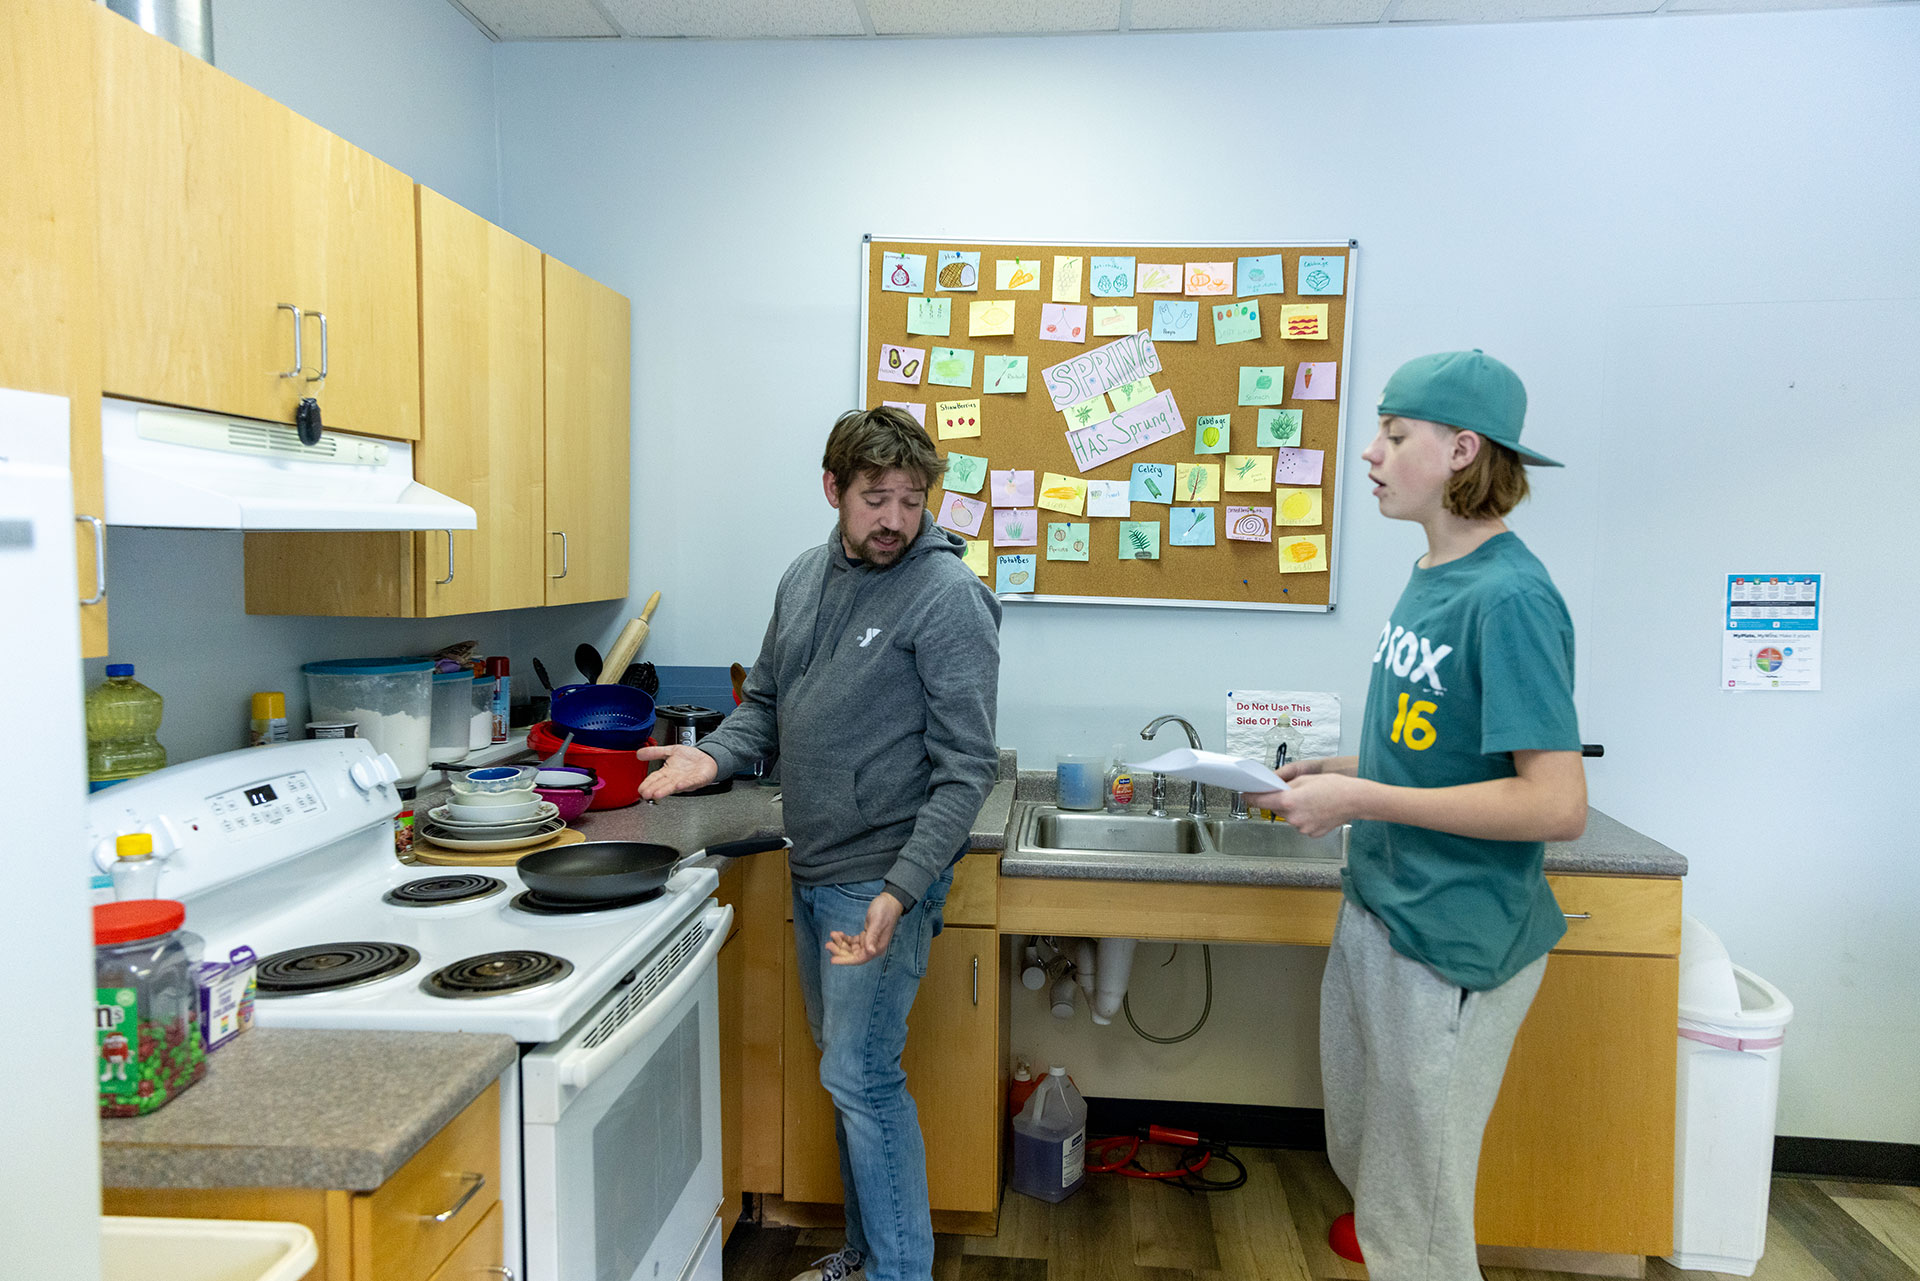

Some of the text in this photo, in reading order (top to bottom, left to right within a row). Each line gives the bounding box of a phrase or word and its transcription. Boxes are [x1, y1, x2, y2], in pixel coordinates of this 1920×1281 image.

[1052, 331, 1160, 405] SPRING
[1070, 433, 1108, 464] HAS
[1138, 464, 1162, 478] Celery
[1000, 556, 1029, 565] Potatoes
[1236, 702, 1250, 711] Do
[1252, 703, 1269, 711] Not
[1291, 704, 1311, 712] This
[1236, 717, 1258, 725] Side
[1260, 717, 1271, 725] Of
[1291, 719, 1313, 727] Sink
[1390, 692, 1438, 751] 16
